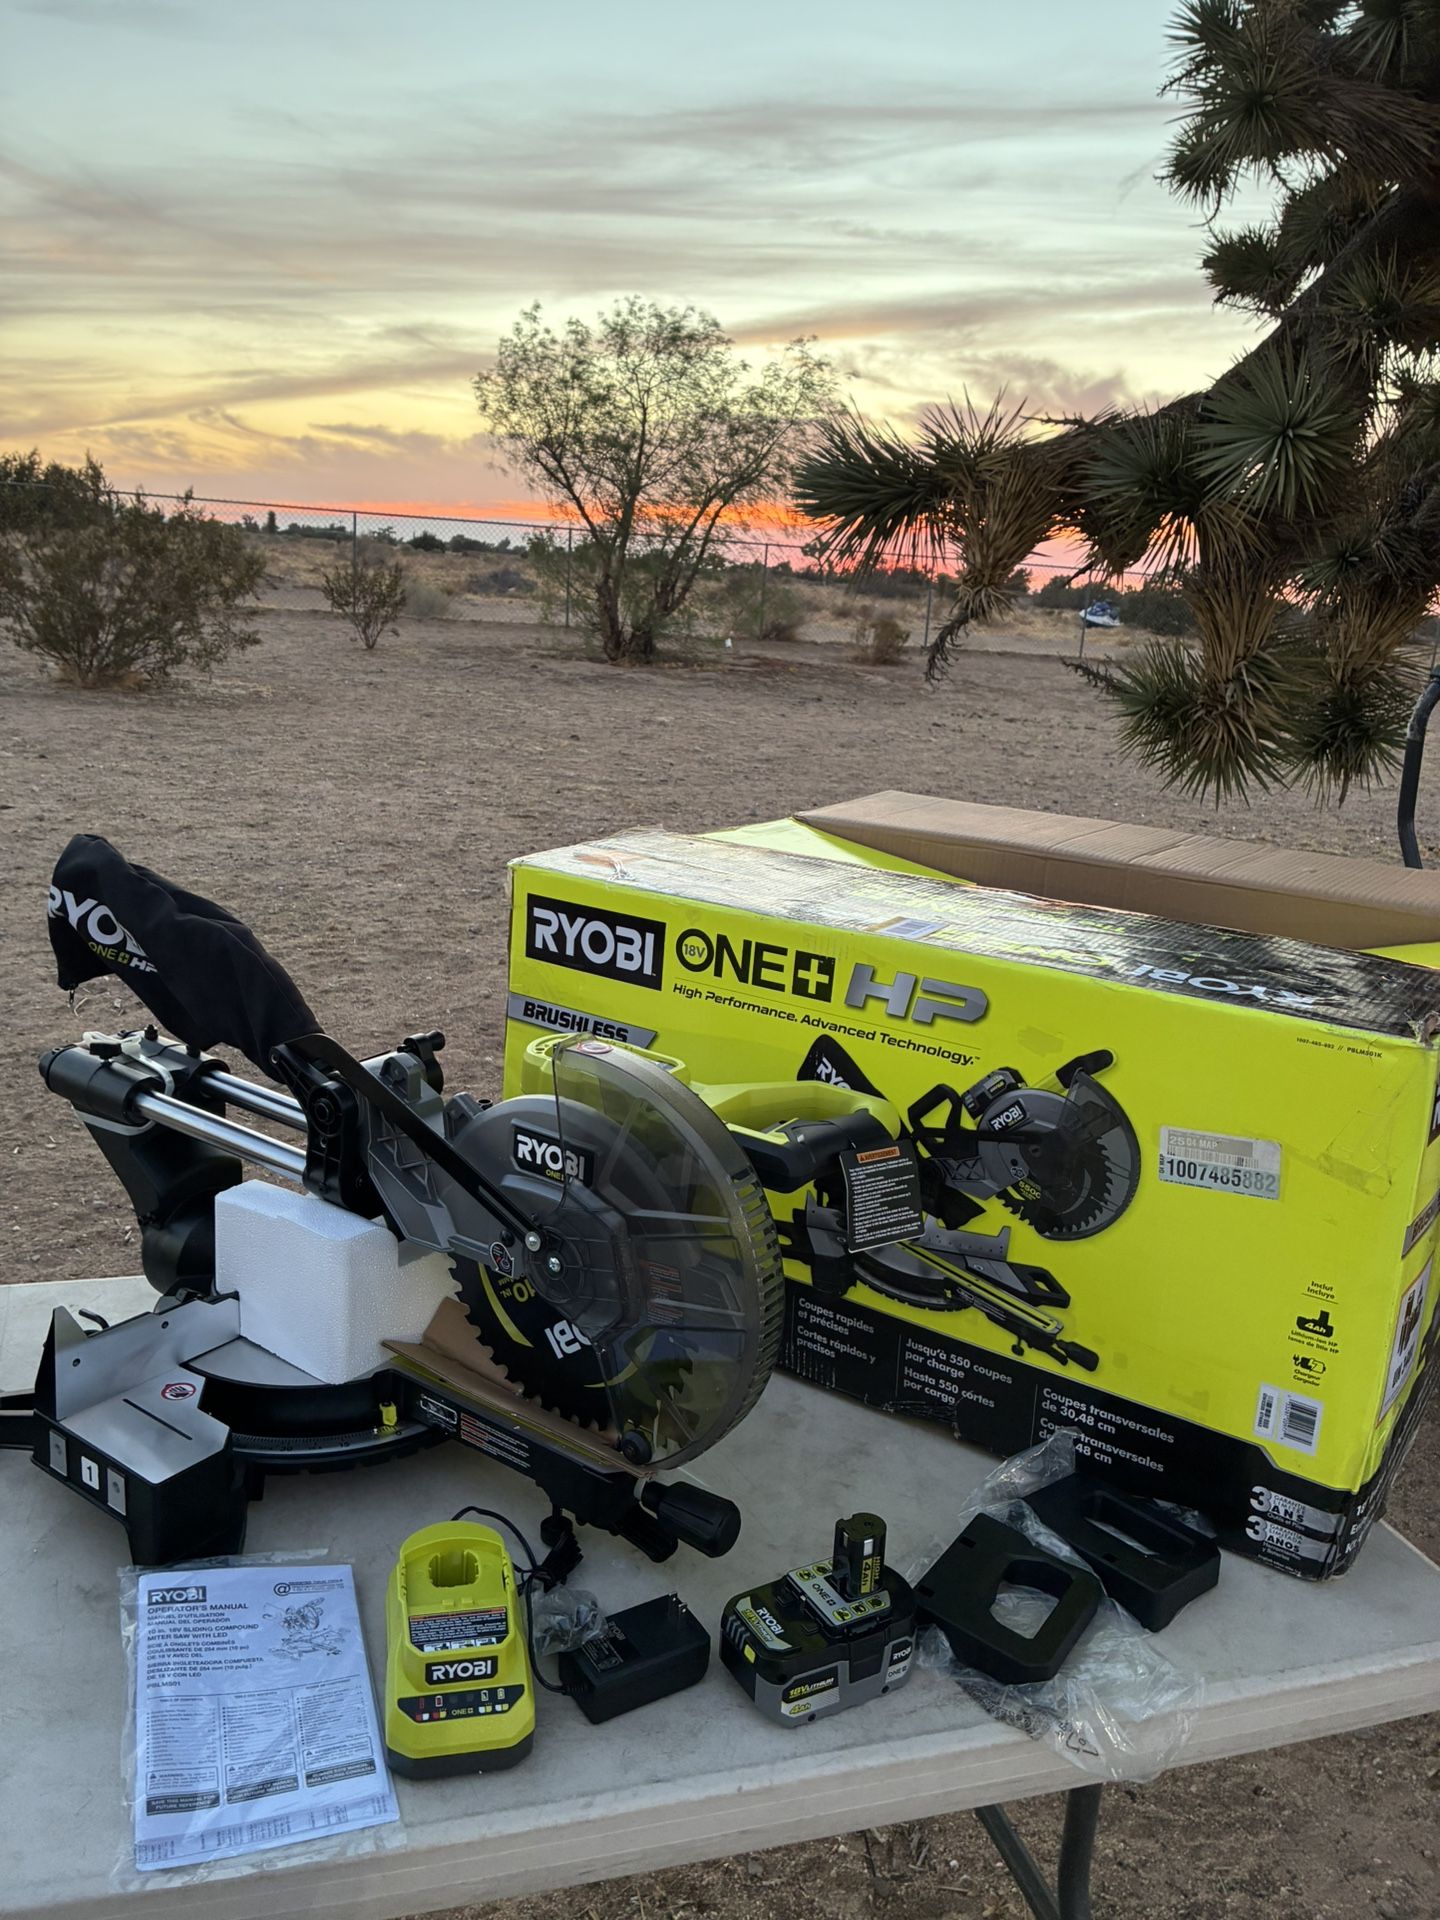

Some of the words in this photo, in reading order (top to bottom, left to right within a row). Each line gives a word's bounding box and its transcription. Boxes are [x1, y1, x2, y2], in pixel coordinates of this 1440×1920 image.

[532, 907, 655, 976] RYOBI
[684, 943, 705, 958] 18V
[844, 963, 988, 1024] HP
[523, 1001, 629, 1043] BRUSHLESS
[673, 982, 702, 1001] High
[705, 990, 798, 1023] Performance.
[801, 1014, 876, 1042] Advanced
[991, 1106, 1022, 1131] RYOBI
[517, 1133, 585, 1181] RYOBI
[1167, 1158, 1276, 1193] 1007485882
[1311, 1281, 1333, 1292] Inclut
[798, 1310, 808, 1319] et
[810, 1313, 849, 1336] précises
[799, 1298, 834, 1319] Coupes
[835, 1312, 874, 1334] rapides
[1304, 1322, 1326, 1334] 4Ah
[796, 1338, 836, 1359] precisos
[797, 1326, 828, 1345] Cortes
[829, 1336, 868, 1360] rápidos
[868, 1355, 877, 1364] y
[905, 1338, 946, 1361] Jusqu'à
[949, 1352, 970, 1369] 550
[972, 1364, 1013, 1385] coupes
[905, 1351, 925, 1366] par
[926, 1357, 965, 1379] charge
[903, 1378, 922, 1393] por
[904, 1366, 936, 1386] Hasta
[938, 1379, 958, 1394] 550
[1042, 1400, 1057, 1412] de
[1059, 1406, 1095, 1426] 30,48
[1097, 1421, 1116, 1435] cm
[1043, 1388, 1087, 1411] Coupes
[1089, 1405, 1175, 1443] transversales
[1080, 1433, 1164, 1473] transversales
[1094, 1452, 1112, 1465] cm
[87, 1465, 93, 1482] 1
[1250, 1485, 1272, 1512] 3
[1245, 1515, 1268, 1541] 3
[862, 1561, 871, 1586] 4Ah
[147, 1604, 207, 1614] OPERATOR'S
[209, 1603, 248, 1611] MANUAL
[150, 1588, 205, 1603] RYOBI
[756, 1607, 785, 1635] RYOBI
[431, 1660, 492, 1681] RYOBI
